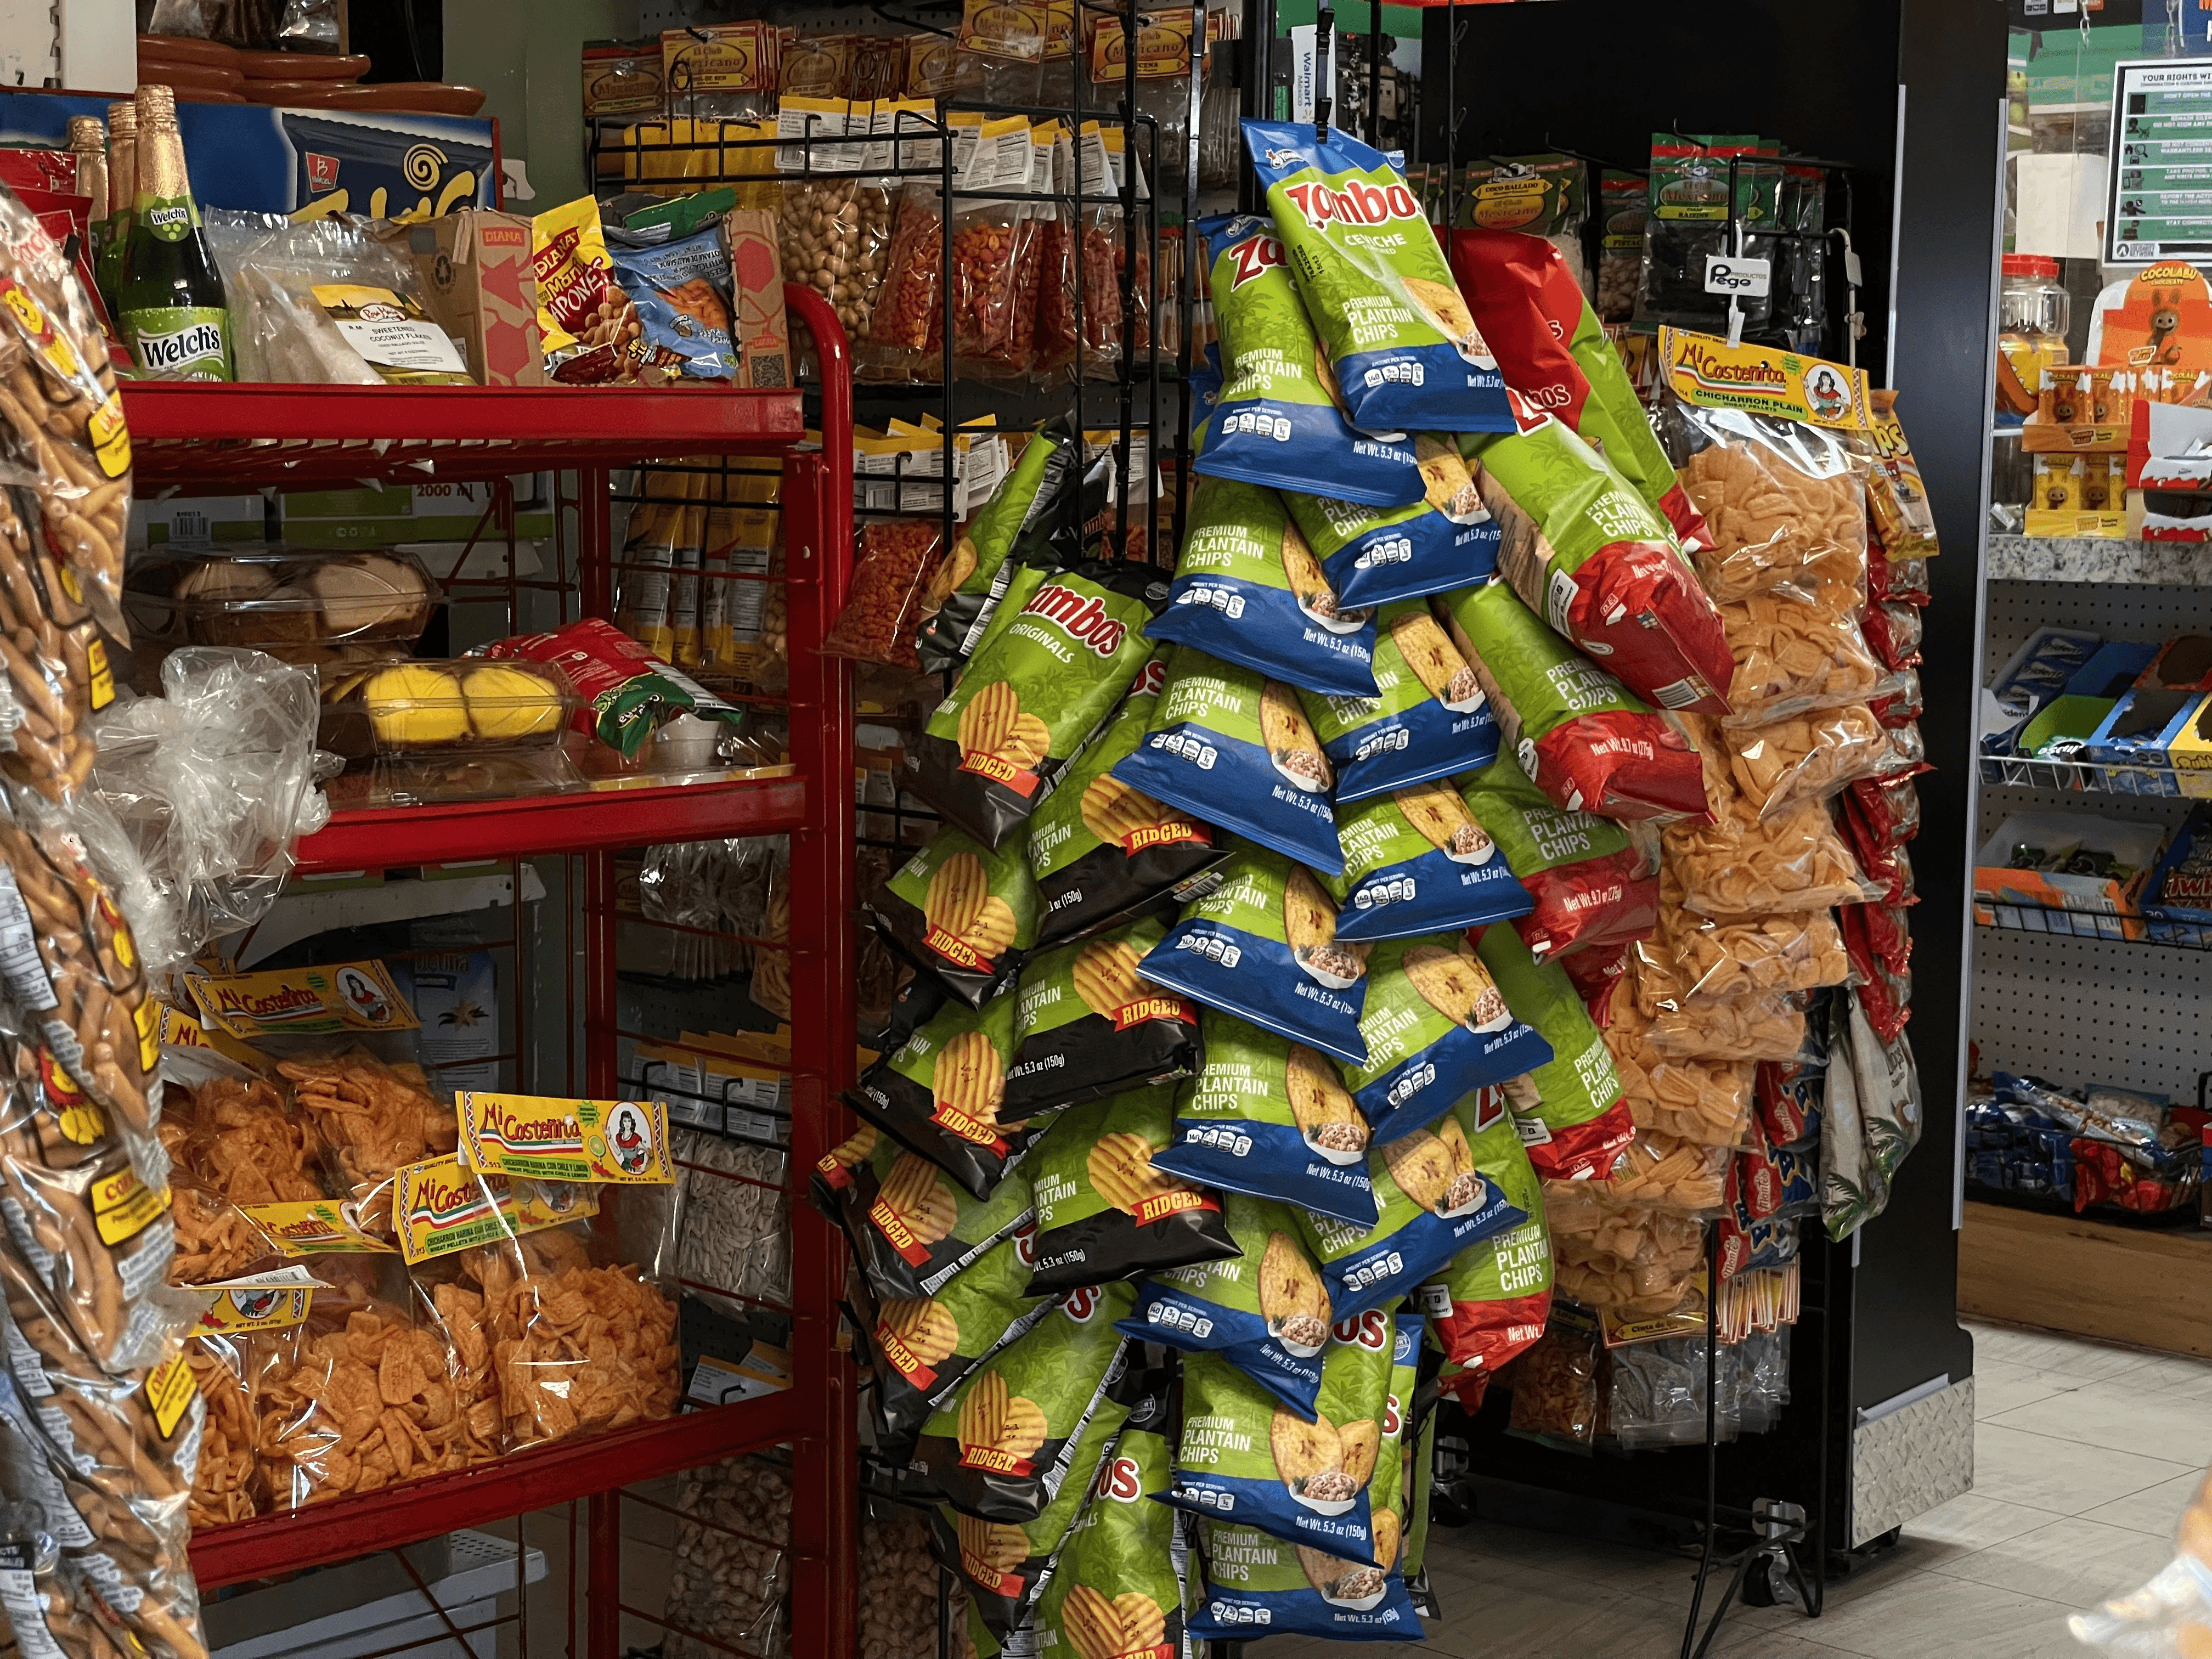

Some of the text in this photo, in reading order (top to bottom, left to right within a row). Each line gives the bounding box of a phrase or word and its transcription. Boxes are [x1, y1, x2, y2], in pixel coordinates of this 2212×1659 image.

[1304, 52, 1312, 107] Walmart
[154, 208, 185, 224] Welch's
[486, 231, 522, 243] DIANA
[1345, 234, 1407, 247] CEVICHE
[534, 232, 576, 277] DIANA
[1342, 297, 1393, 312] PREMIUM
[1347, 309, 1414, 326] PLANTAIN
[1353, 324, 1398, 345] CHIPS
[141, 326, 221, 366] Welch's
[1677, 343, 1703, 371] Mi
[1229, 376, 1272, 395] CHIPS
[1696, 390, 1802, 414] CHICHARRON PLAIN
[1745, 404, 1777, 412] PELLETS
[1353, 441, 1401, 461] Net Wt. 5.3 oz
[417, 484, 450, 497] 2000
[1193, 526, 1247, 538] PREMIUM
[1603, 520, 1652, 538] CHIPS
[1187, 551, 1232, 568] CHIPS
[1190, 538, 1264, 560] PLANTAIN
[1010, 623, 1075, 664] ORIGINALS
[1304, 628, 1349, 653] Net Wt. 5.3 oz
[1173, 678, 1226, 691] PREMIUM
[1166, 702, 1207, 720] CHIPS
[1169, 689, 1241, 713] PLANTAIN
[1336, 698, 1380, 725] CHIPS
[1590, 740, 1623, 756] Net Wt.
[966, 752, 1017, 782] RIDGED
[1272, 785, 1318, 813] Net Wt. 5.3 oz
[1131, 823, 1192, 849] RIDGED
[1540, 832, 1591, 861] CHIPS
[1345, 845, 1384, 877] CHIPS
[1482, 868, 1491, 881] 5.3
[1054, 888, 1082, 909] oz (150g)
[1564, 893, 1592, 912] Net Wt.
[1295, 983, 1340, 1009] Net Wt. 5.3 oz
[1123, 999, 1180, 1025] RIDGED
[173, 1023, 197, 1046] Mi
[1504, 1033, 1513, 1043] 5.3
[1025, 1053, 1064, 1074] 5.3 oz (150g)
[1363, 1037, 1404, 1073] CHIPS
[1196, 1077, 1268, 1097] PLANTAIN
[1590, 1075, 1618, 1109] CHIPS
[1193, 1094, 1238, 1111] CHIPS
[481, 1103, 502, 1130] Mi
[939, 1108, 996, 1144] RIDGED
[1306, 1164, 1352, 1184] Net Wt. 5.3 oz
[413, 1179, 434, 1212] Mi
[1142, 1192, 1201, 1220] RIDGED
[871, 1203, 913, 1249] RIDGED
[1454, 1214, 1486, 1237] Net 5.3
[1322, 1225, 1367, 1253] CHIPS
[1043, 1257, 1055, 1268] 5.3
[1063, 1249, 1085, 1264] (150g)
[1500, 1264, 1542, 1291] CHIPS
[1509, 1327, 1524, 1342] Net
[881, 1329, 918, 1374] RIDGED
[1187, 1417, 1233, 1431] PREMIUM
[1183, 1430, 1251, 1451] PLANTAIN
[968, 1448, 1017, 1471] RIDGED
[1180, 1447, 1218, 1463] CHIPS
[1214, 1530, 1257, 1546] PREMIUM
[1296, 1516, 1366, 1541] Net Wt. 5.3 oz (150g)
[1213, 1544, 1277, 1564] PLANTAIN
[964, 1556, 1002, 1588] RIDGED
[1213, 1562, 1249, 1581] CHIPS
